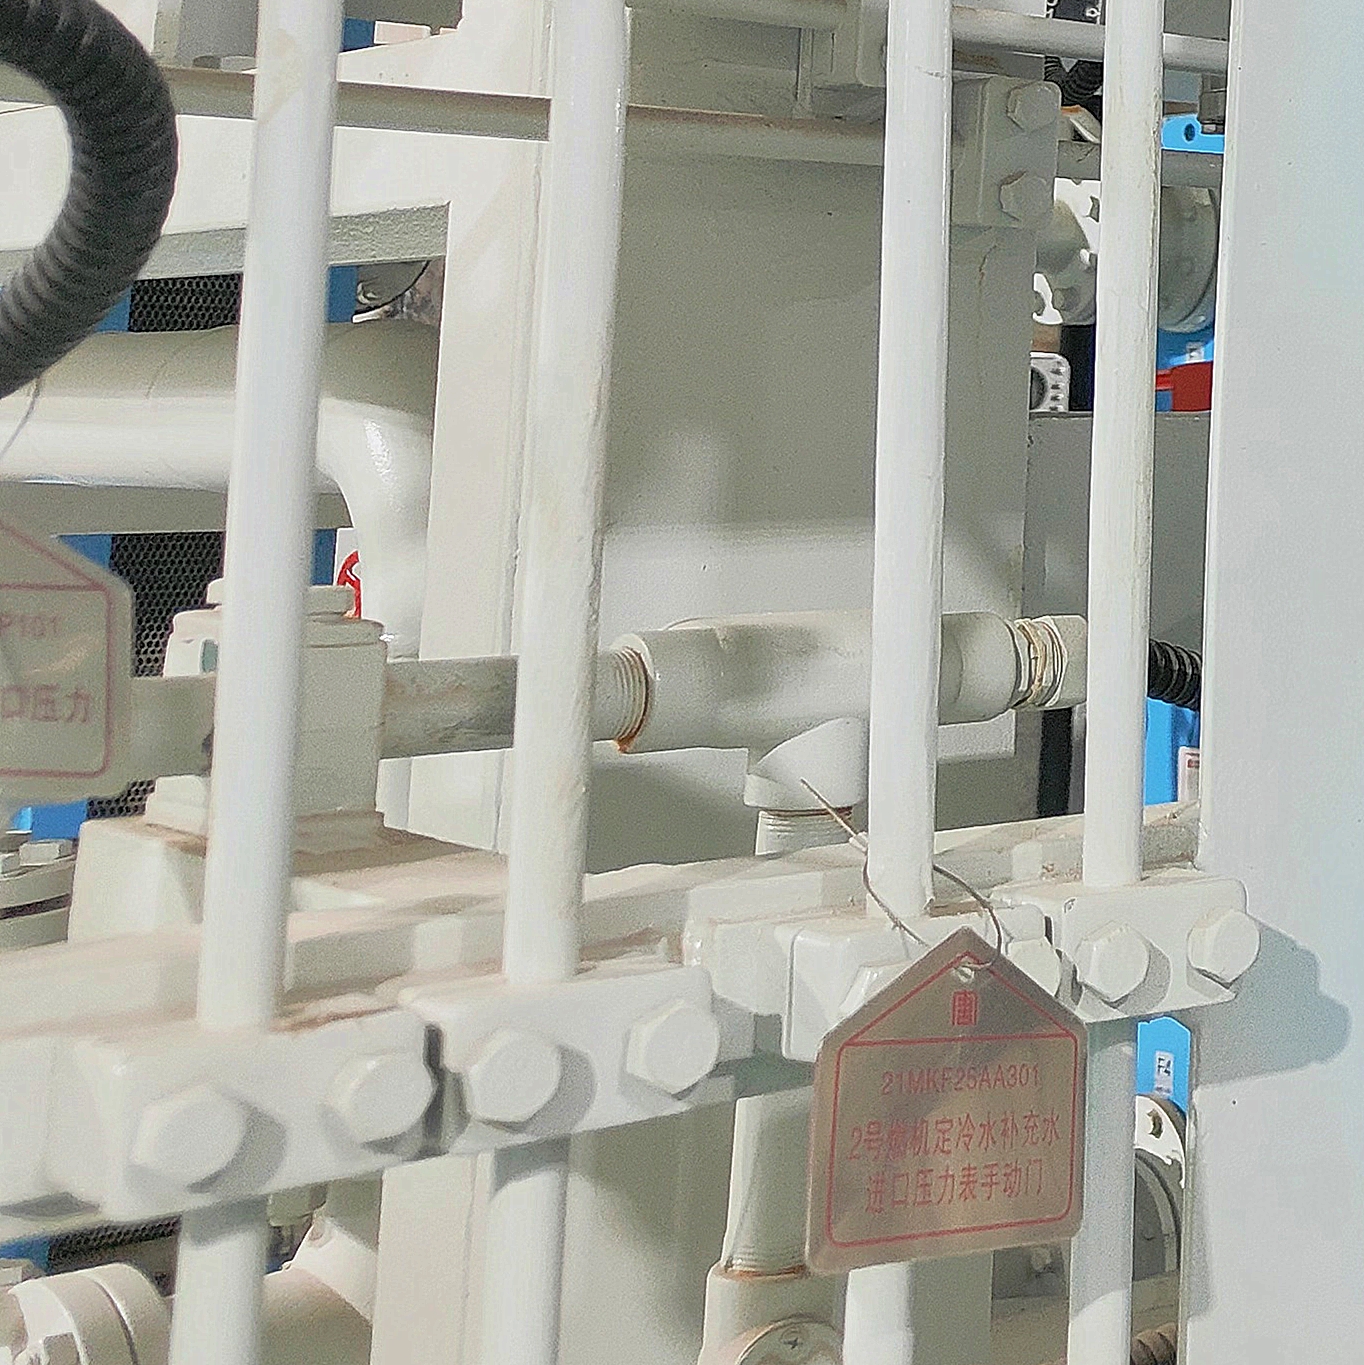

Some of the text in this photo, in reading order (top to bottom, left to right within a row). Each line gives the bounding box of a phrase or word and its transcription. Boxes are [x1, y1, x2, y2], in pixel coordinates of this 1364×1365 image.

[866, 1158, 1043, 1214] 进口压力表手动门
